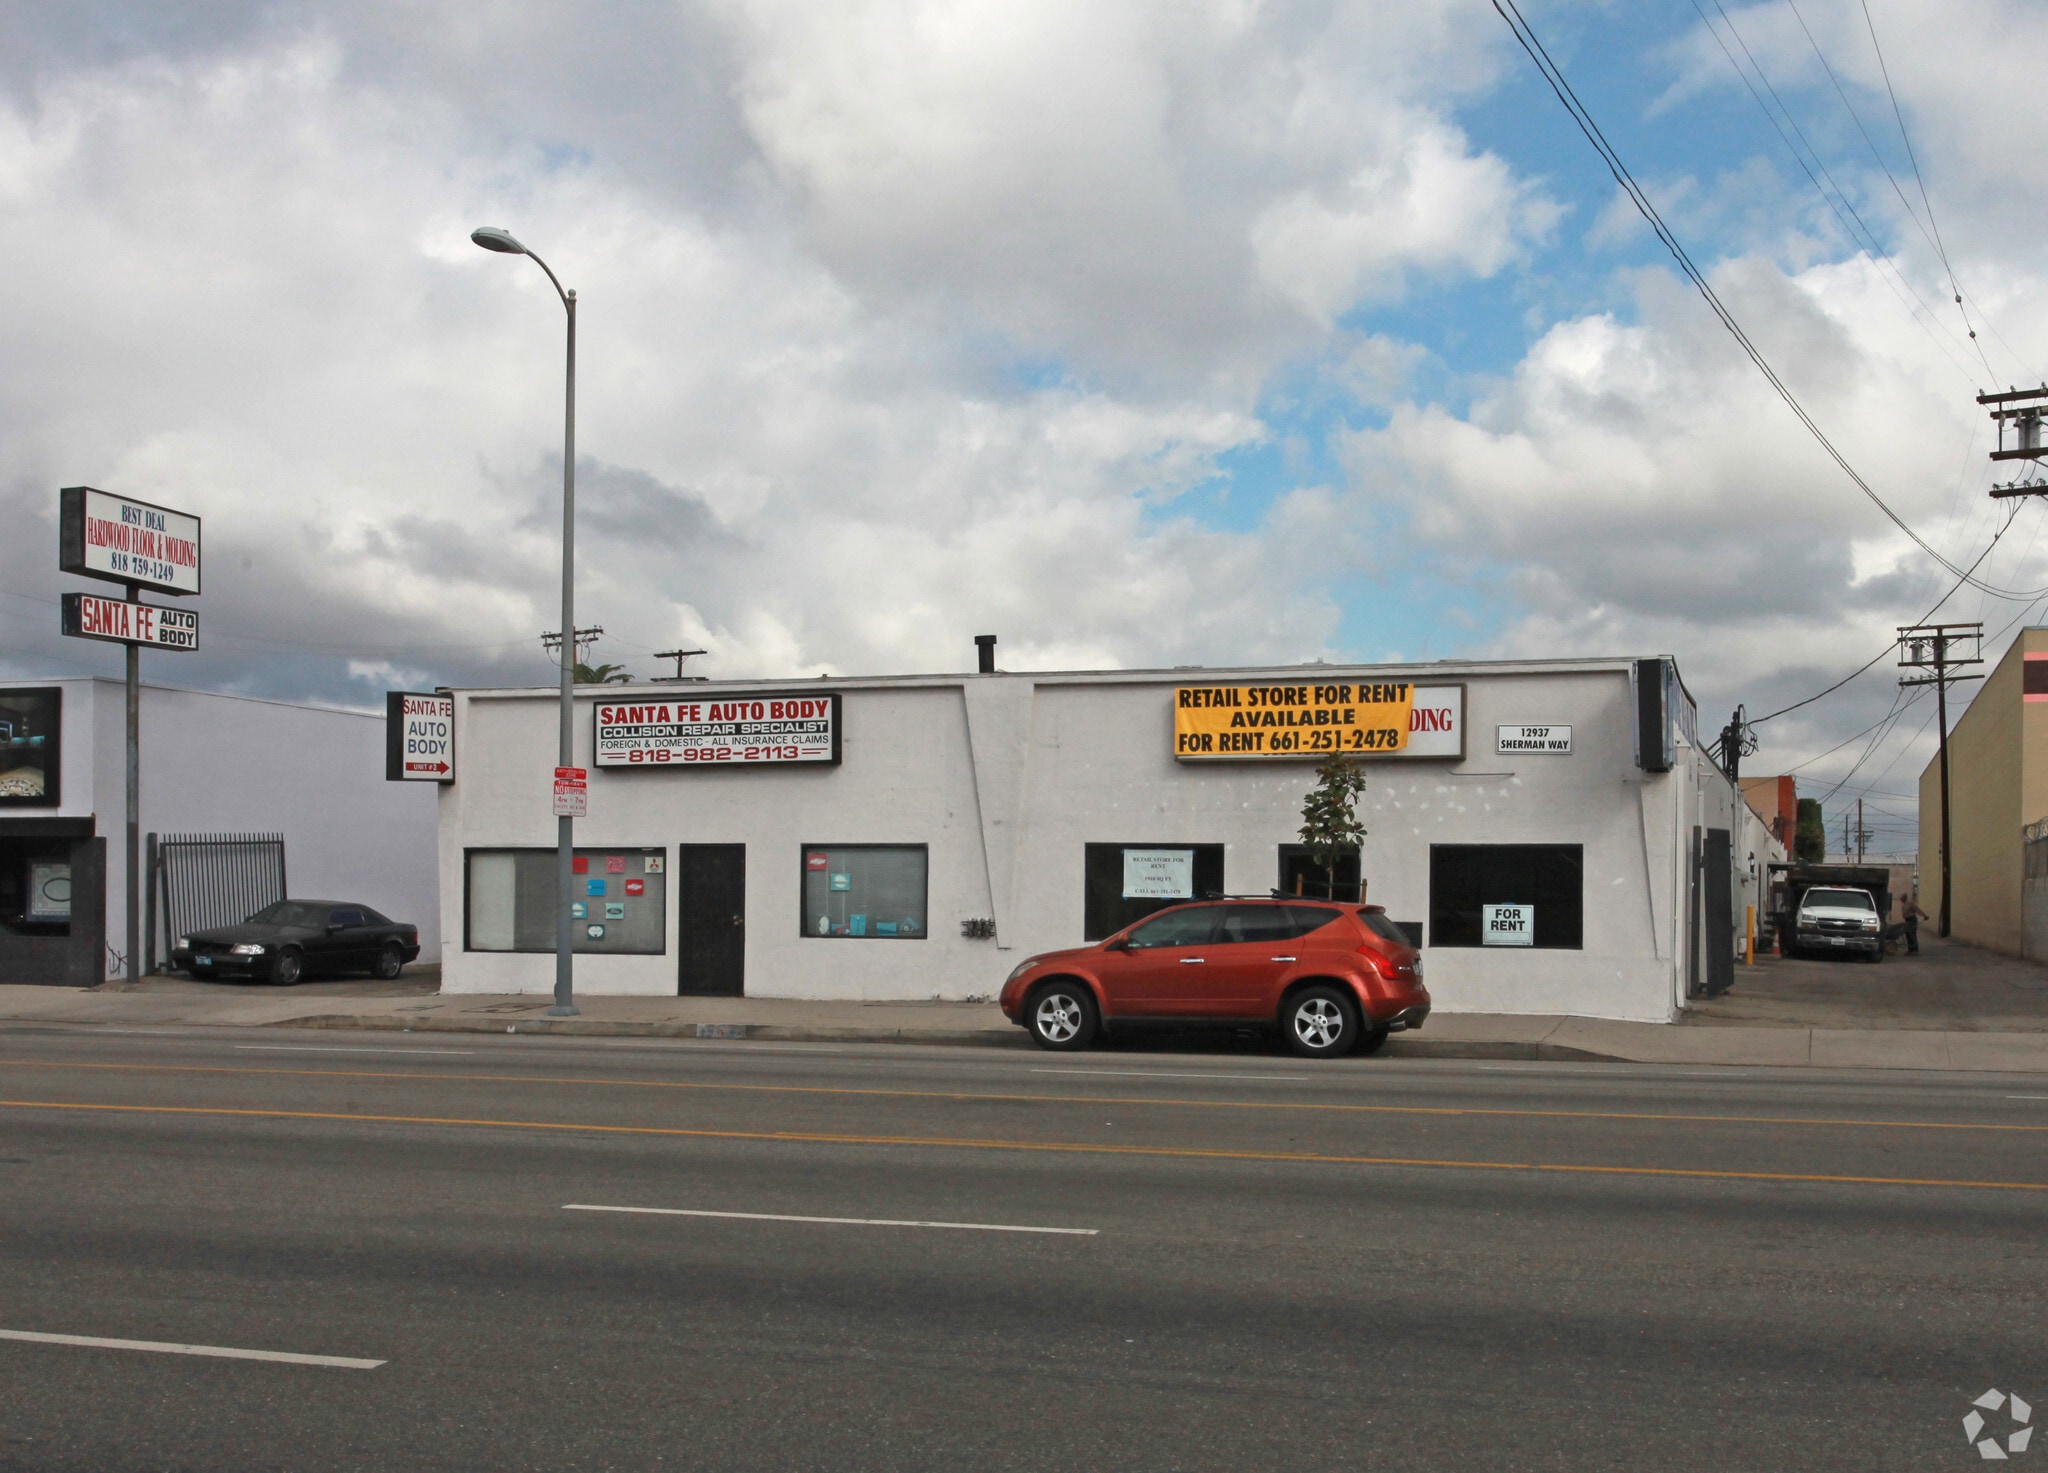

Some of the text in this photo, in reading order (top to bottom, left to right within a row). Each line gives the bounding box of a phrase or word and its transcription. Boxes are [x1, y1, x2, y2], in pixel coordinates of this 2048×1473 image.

[122, 504, 166, 532] BEST DEAL
[88, 517, 196, 568] HARDWOOD FLOOR & MOLDING
[111, 552, 128, 572] 818
[83, 598, 153, 641] SANTA FE
[160, 610, 195, 628] AUTO
[160, 628, 194, 646] BODY
[1179, 683, 1409, 708] RETAIL STORE FOR RENT
[403, 699, 452, 717] SANTA FE
[600, 700, 829, 725] SANTA FE AUTO BODY
[1230, 709, 1355, 727] AVAILABLE
[408, 721, 447, 737] AUTO
[602, 721, 827, 738] COLLISION REPAIR SPECIALIST
[1521, 728, 1550, 737] 12937
[408, 739, 447, 755] BODY
[600, 740, 641, 749] FOREIGN
[644, 739, 651, 748] &
[655, 738, 704, 747] DOMESTIC
[711, 737, 729, 746] ALL
[732, 735, 788, 745] INSURANCE
[791, 735, 829, 744] CLAIMS
[1179, 729, 1399, 752] FOR RENT 661-251-2478
[1501, 739, 1569, 749] SHERMAN WAY
[628, 745, 799, 763] 818-982-2113
[555, 785, 564, 794] NO
[1495, 908, 1521, 919] FOR
[1490, 920, 1525, 931] RENT
